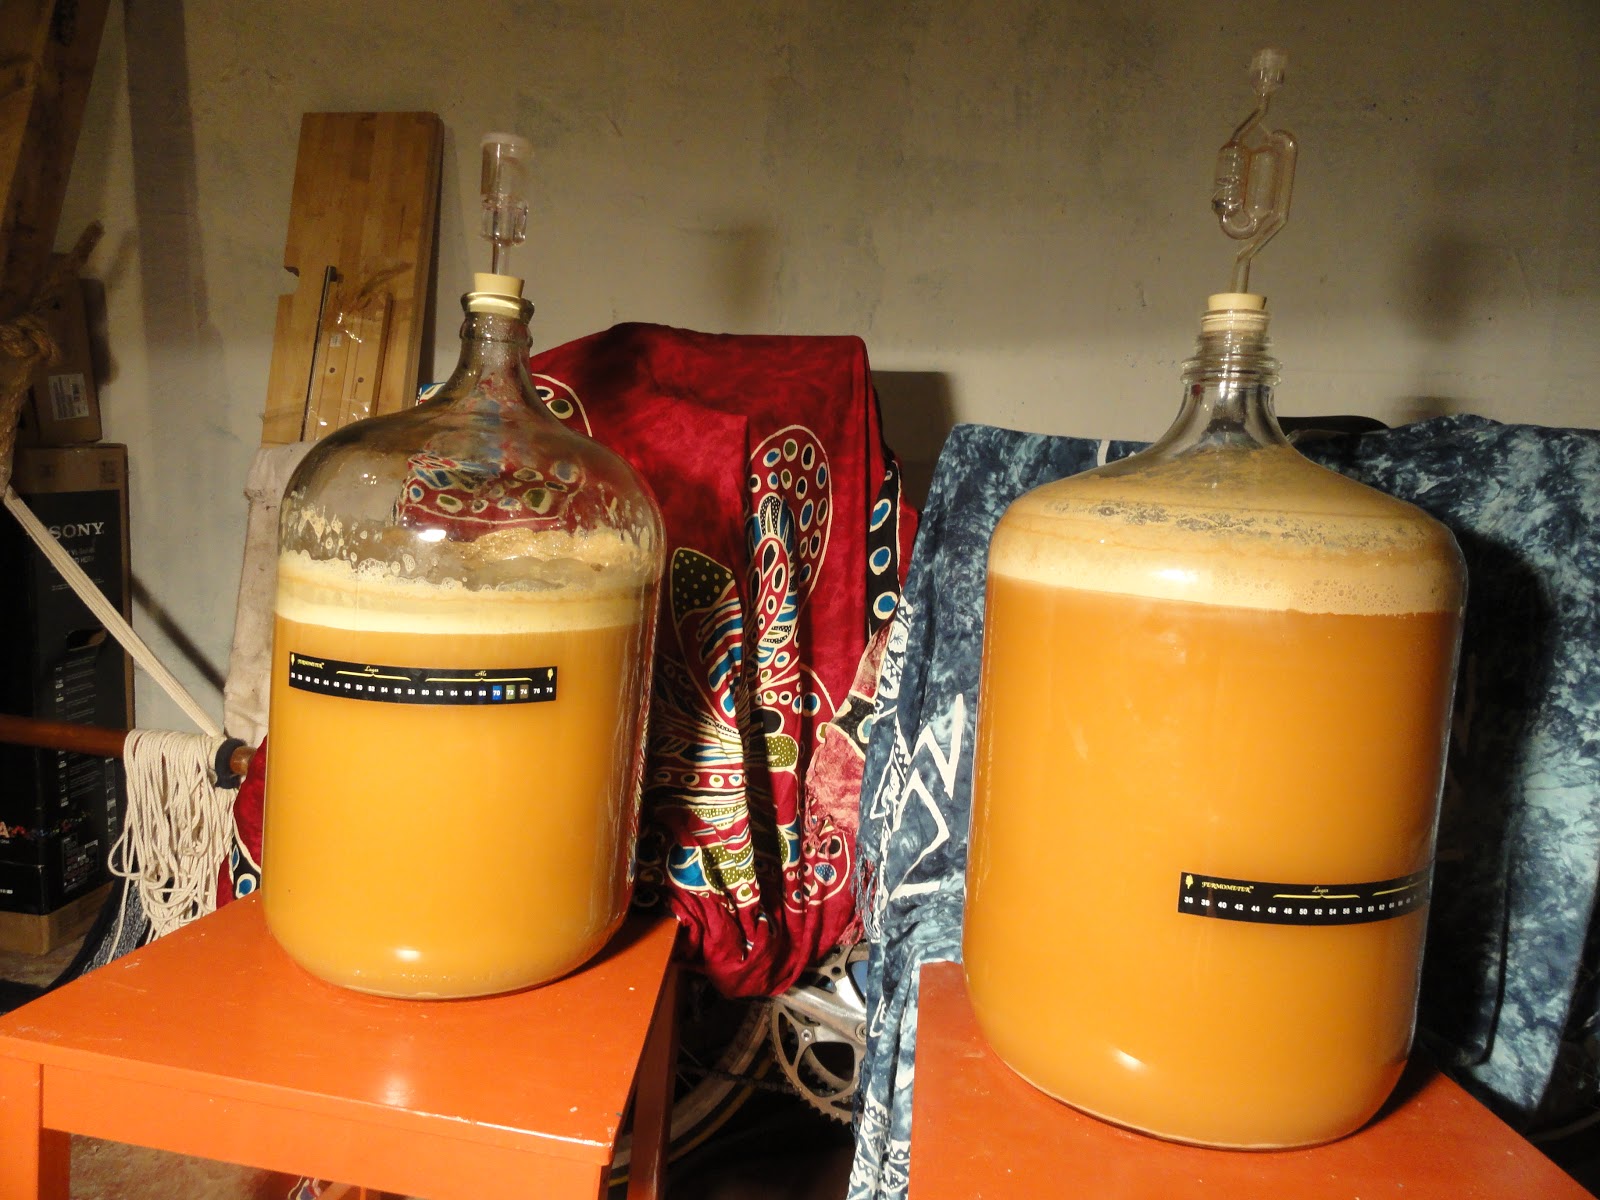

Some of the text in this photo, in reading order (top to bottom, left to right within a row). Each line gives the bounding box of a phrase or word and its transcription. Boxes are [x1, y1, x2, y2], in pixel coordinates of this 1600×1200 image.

[48, 521, 104, 539] SONY
[380, 686, 389, 694] 54
[435, 689, 444, 697] 62
[492, 689, 501, 697] 70
[1183, 895, 1194, 904] 36
[1200, 898, 1211, 907] 38
[1217, 901, 1228, 909] 40
[1234, 903, 1244, 911] 42
[1250, 905, 1261, 913] 44
[1267, 906, 1277, 914] 46
[1283, 907, 1293, 915] 48
[1298, 907, 1308, 916] 50
[1314, 908, 1323, 916] 52
[1328, 908, 1337, 916] 54
